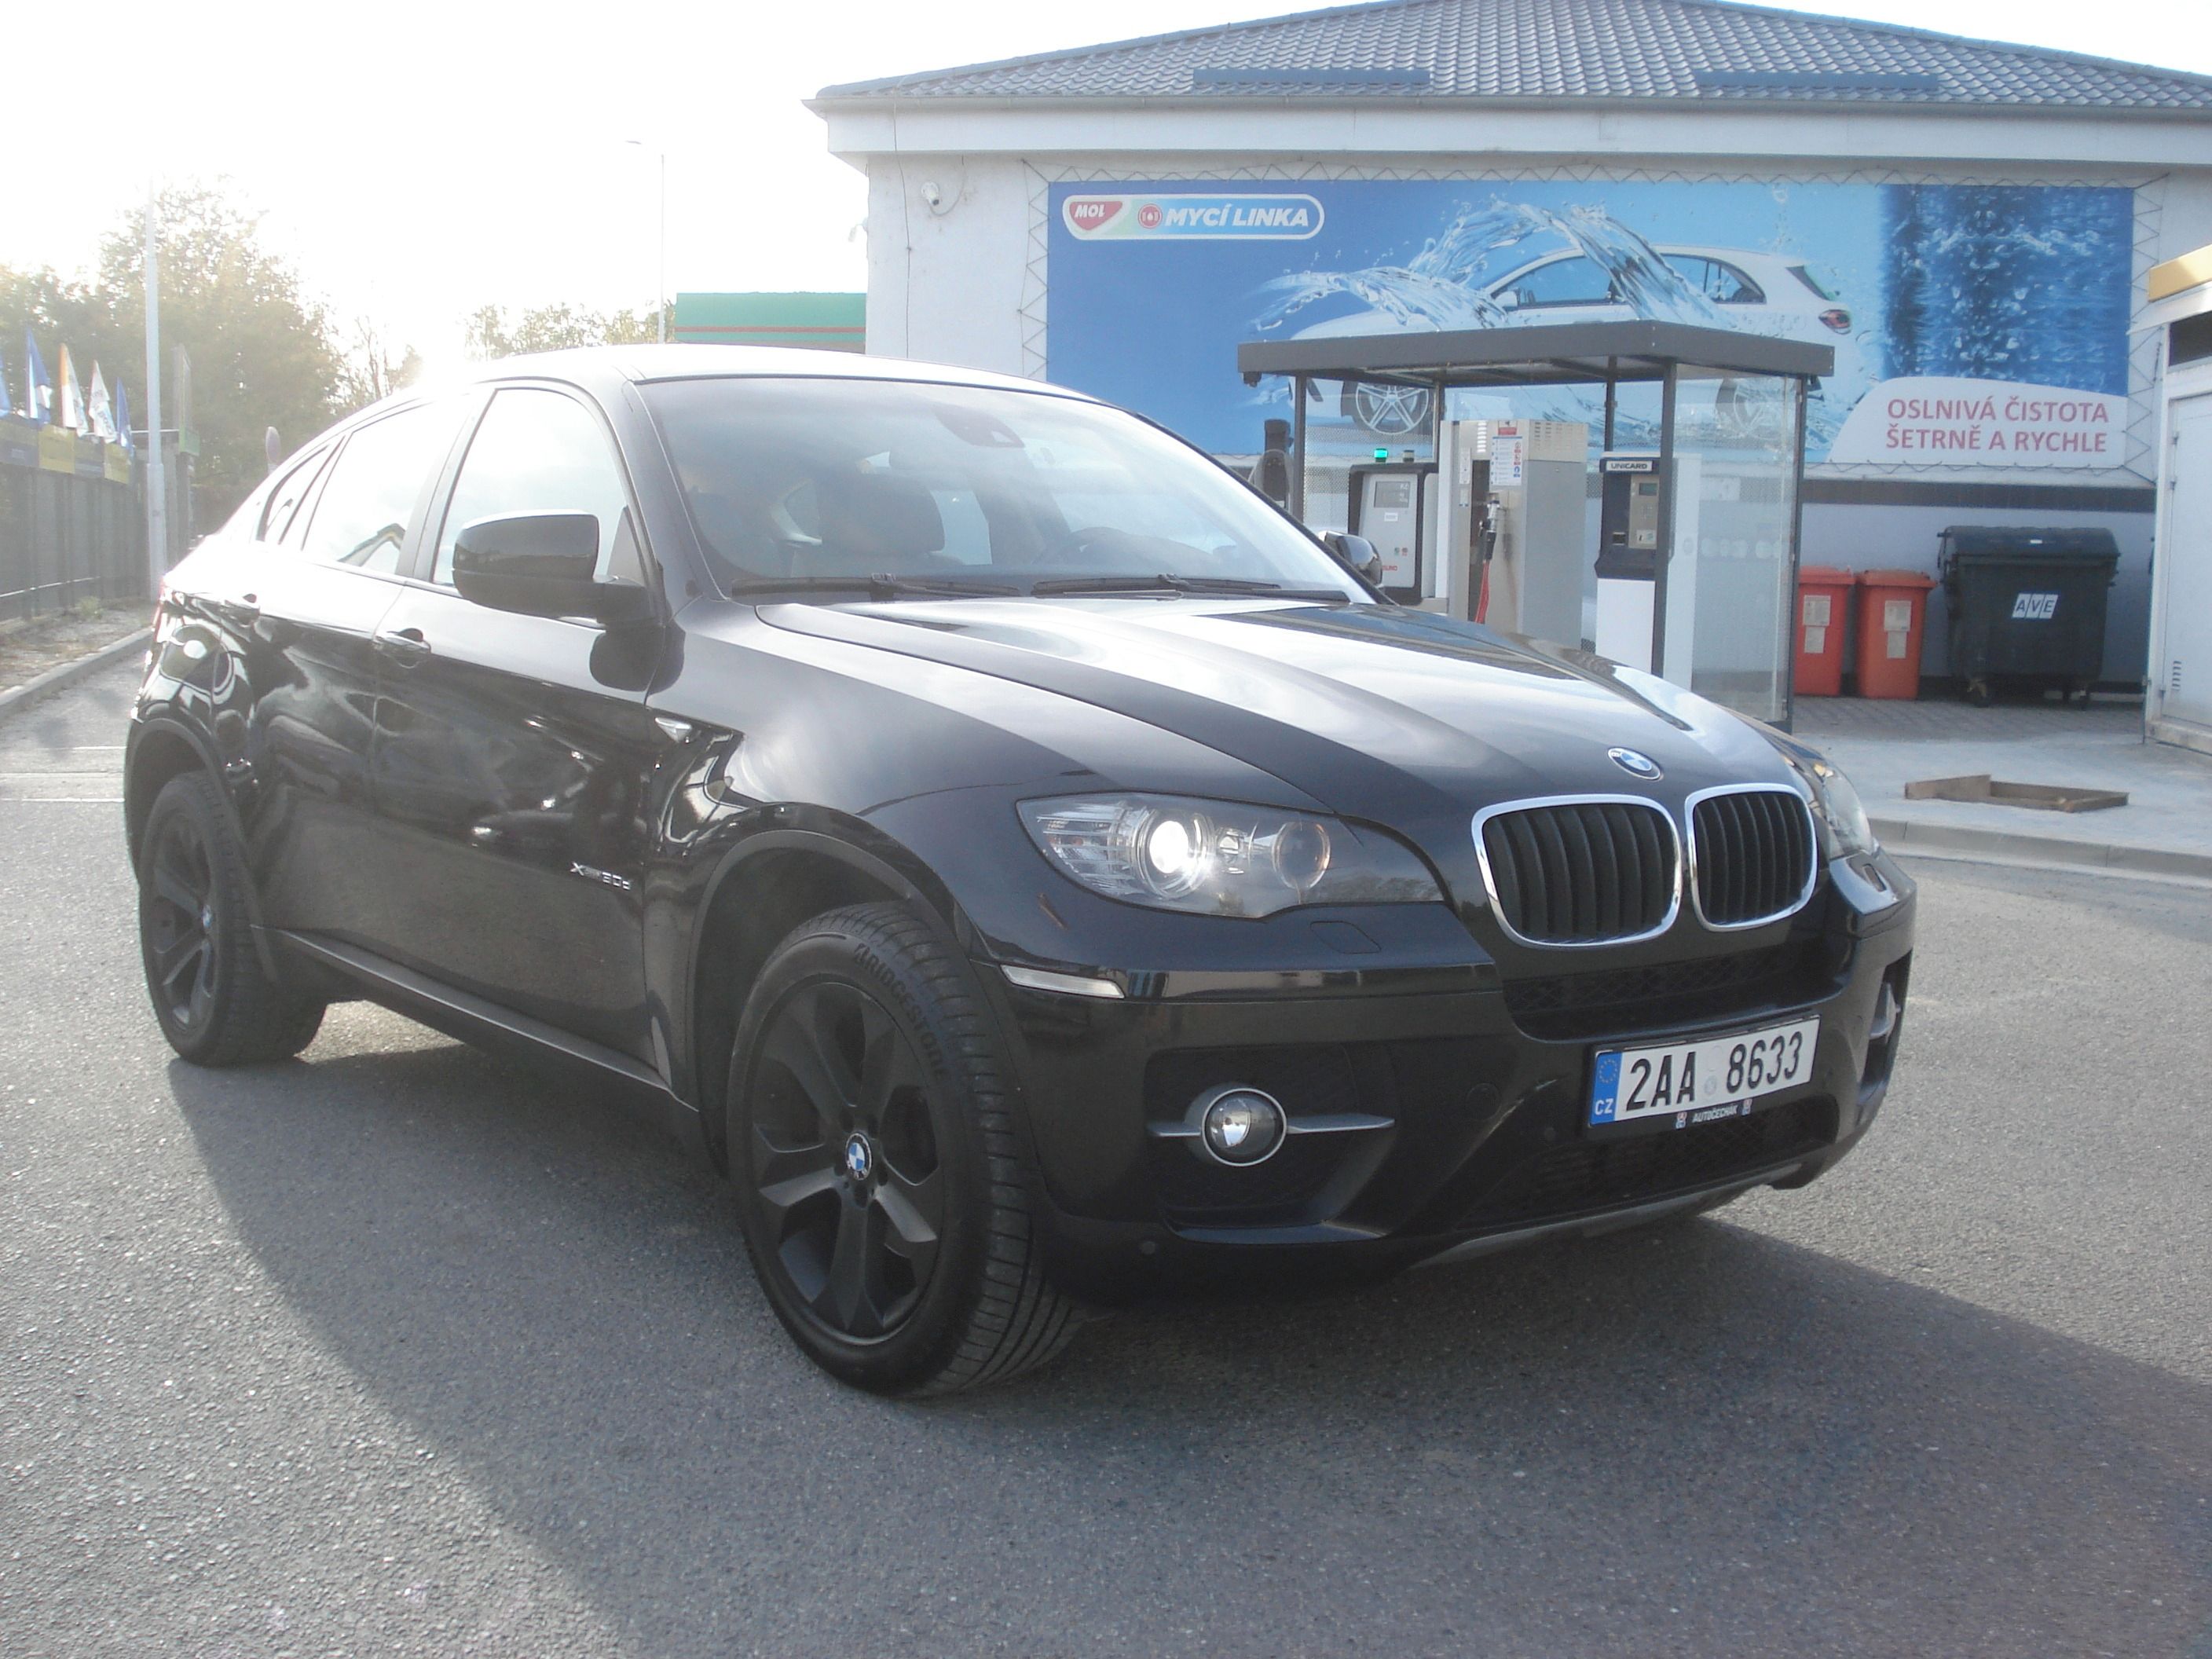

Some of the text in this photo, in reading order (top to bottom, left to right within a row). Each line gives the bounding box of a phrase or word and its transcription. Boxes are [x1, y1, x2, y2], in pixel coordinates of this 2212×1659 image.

[1074, 203, 1106, 218] MOL
[1165, 203, 1309, 227] MYCÍ LINKA
[1887, 395, 2109, 423] OSLNIVÁ ČISTOTA
[1886, 423, 2108, 453] ŠETRNĚ A RYCHLE
[2016, 599, 2056, 613] AVE
[1625, 1031, 1804, 1112] 2AA 8633
[1595, 1098, 1614, 1116] CZ
